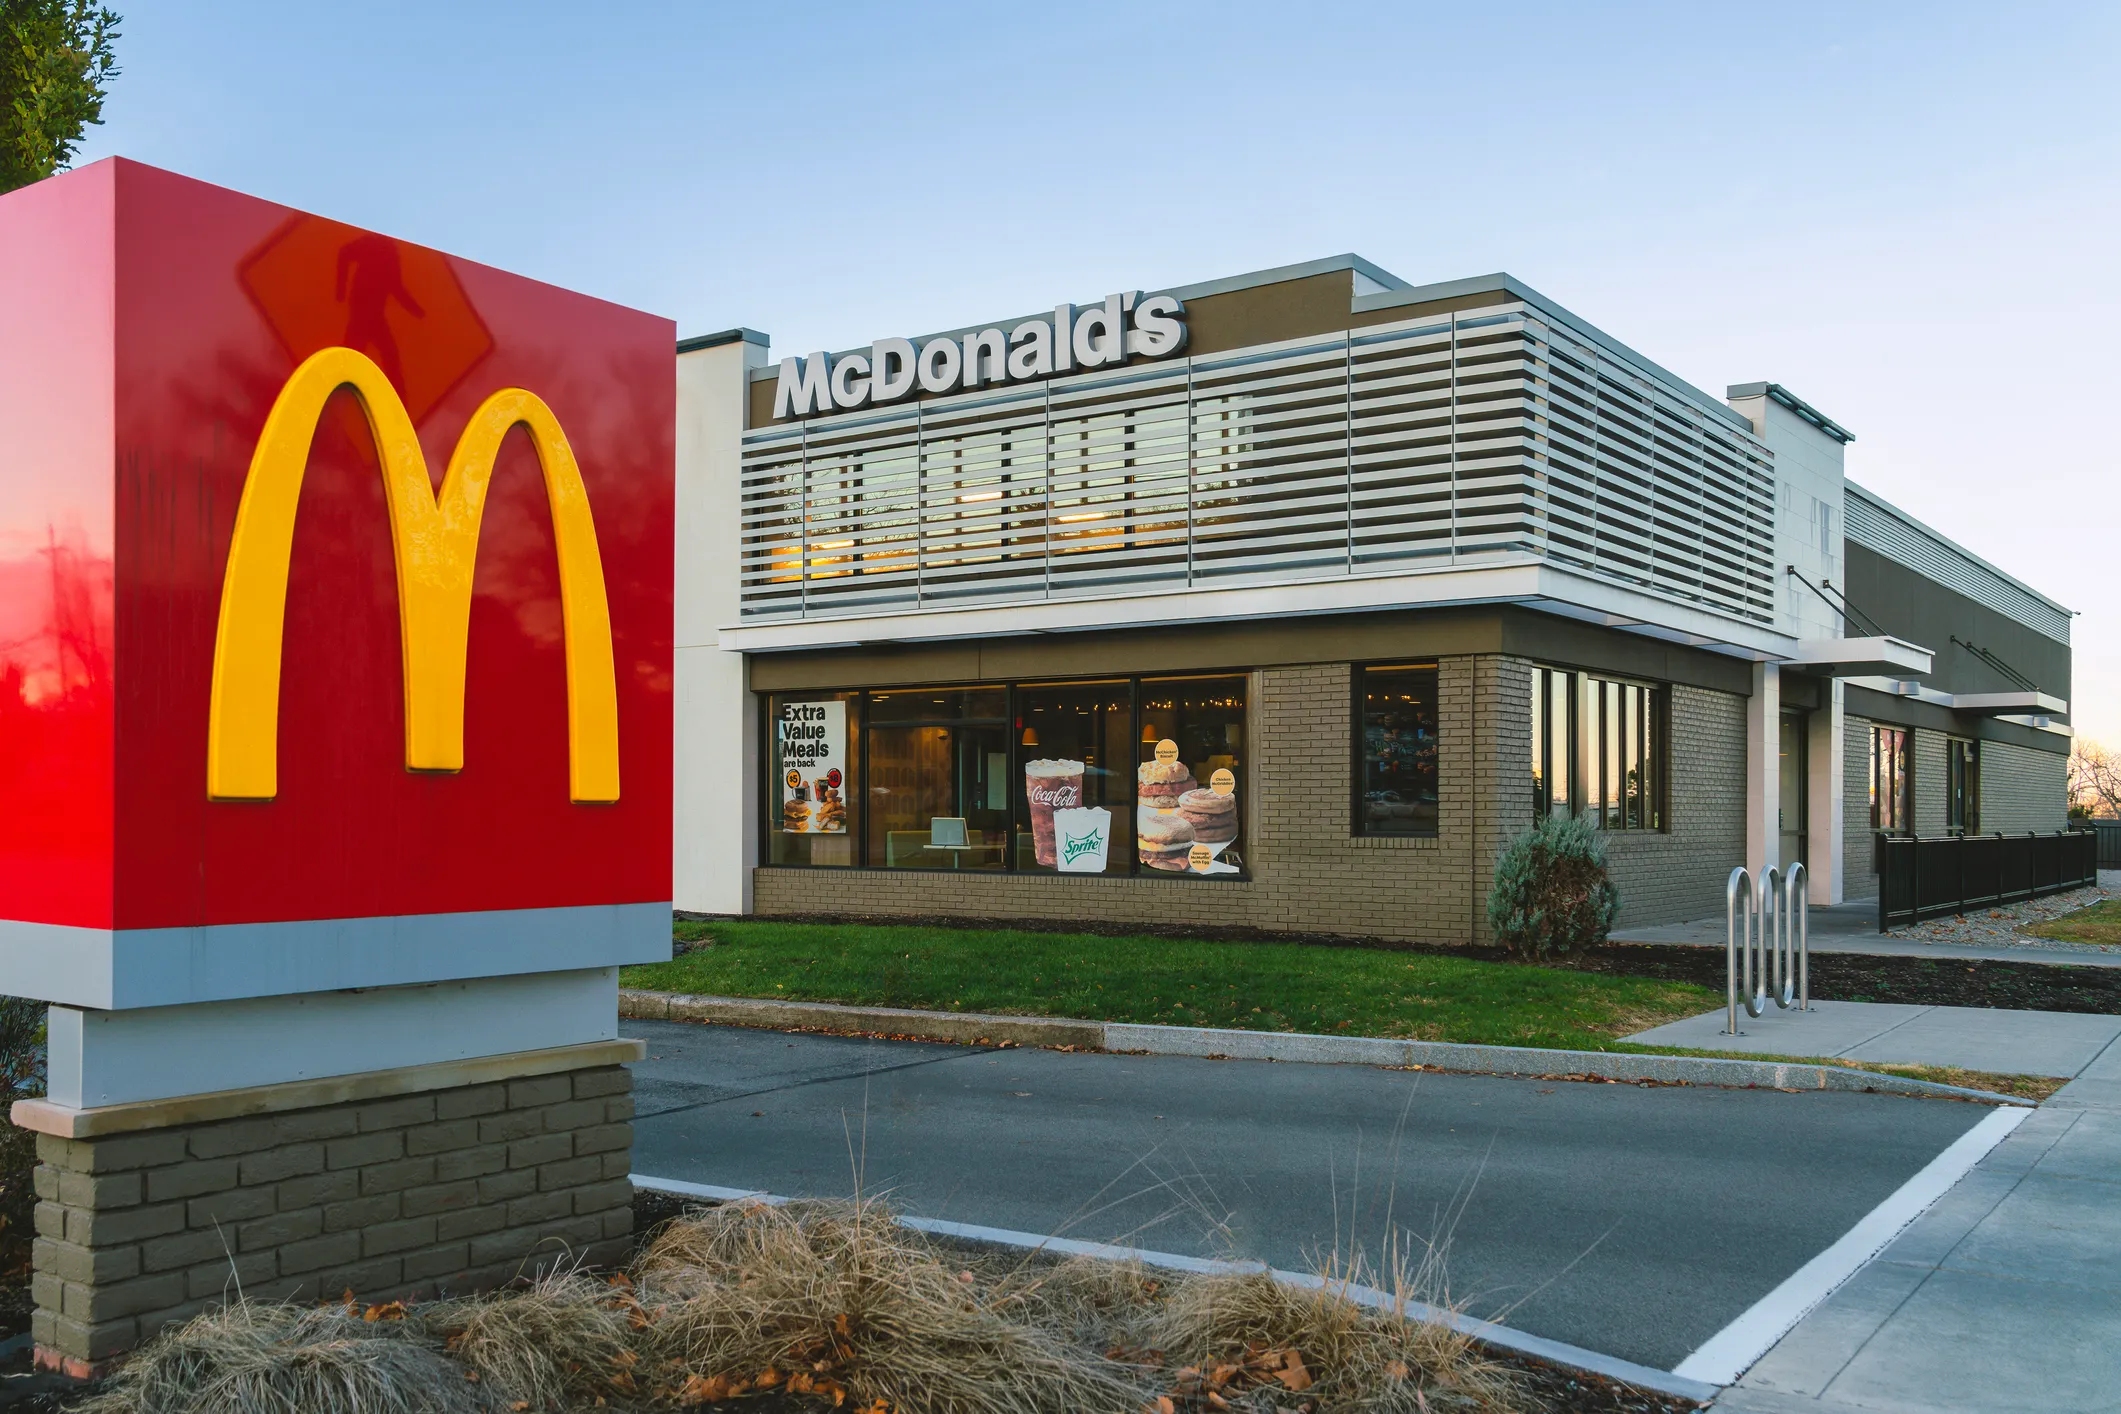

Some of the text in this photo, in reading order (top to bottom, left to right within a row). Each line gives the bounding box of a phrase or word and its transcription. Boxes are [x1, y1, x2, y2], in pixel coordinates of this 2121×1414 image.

[773, 290, 1188, 420] McDonald's
[783, 704, 826, 722] Extra
[783, 721, 826, 740] Value
[783, 740, 830, 758] Meals
[784, 758, 816, 768] are back
[789, 774, 798, 784] $5
[1065, 839, 1099, 855] Sprite
